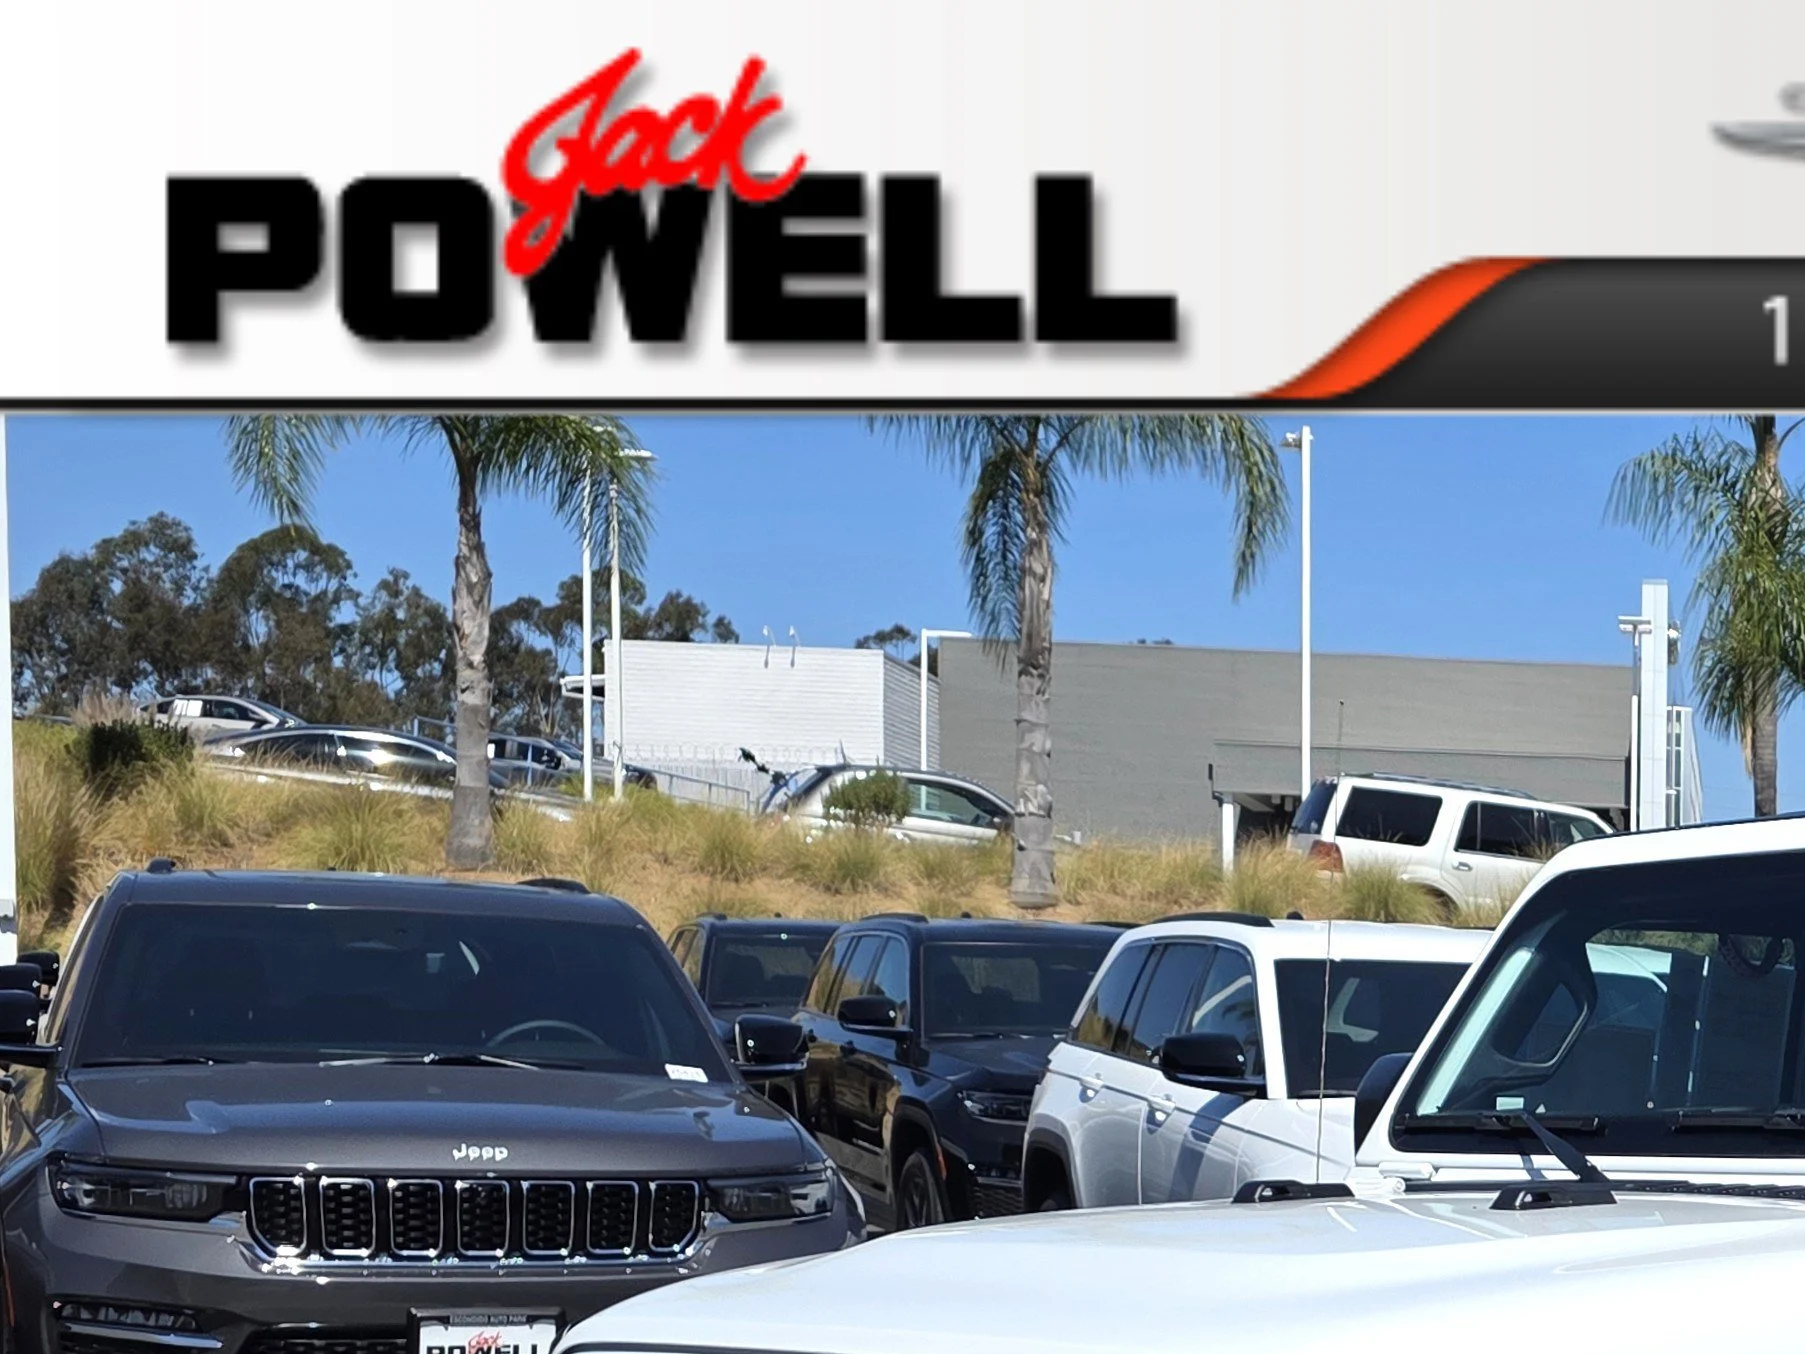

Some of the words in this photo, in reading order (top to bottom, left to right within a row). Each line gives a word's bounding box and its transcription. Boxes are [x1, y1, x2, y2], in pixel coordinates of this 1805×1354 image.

[452, 1143, 508, 1161] Jeep
[490, 1314, 508, 1324] AUTO
[509, 1314, 527, 1323] PARK
